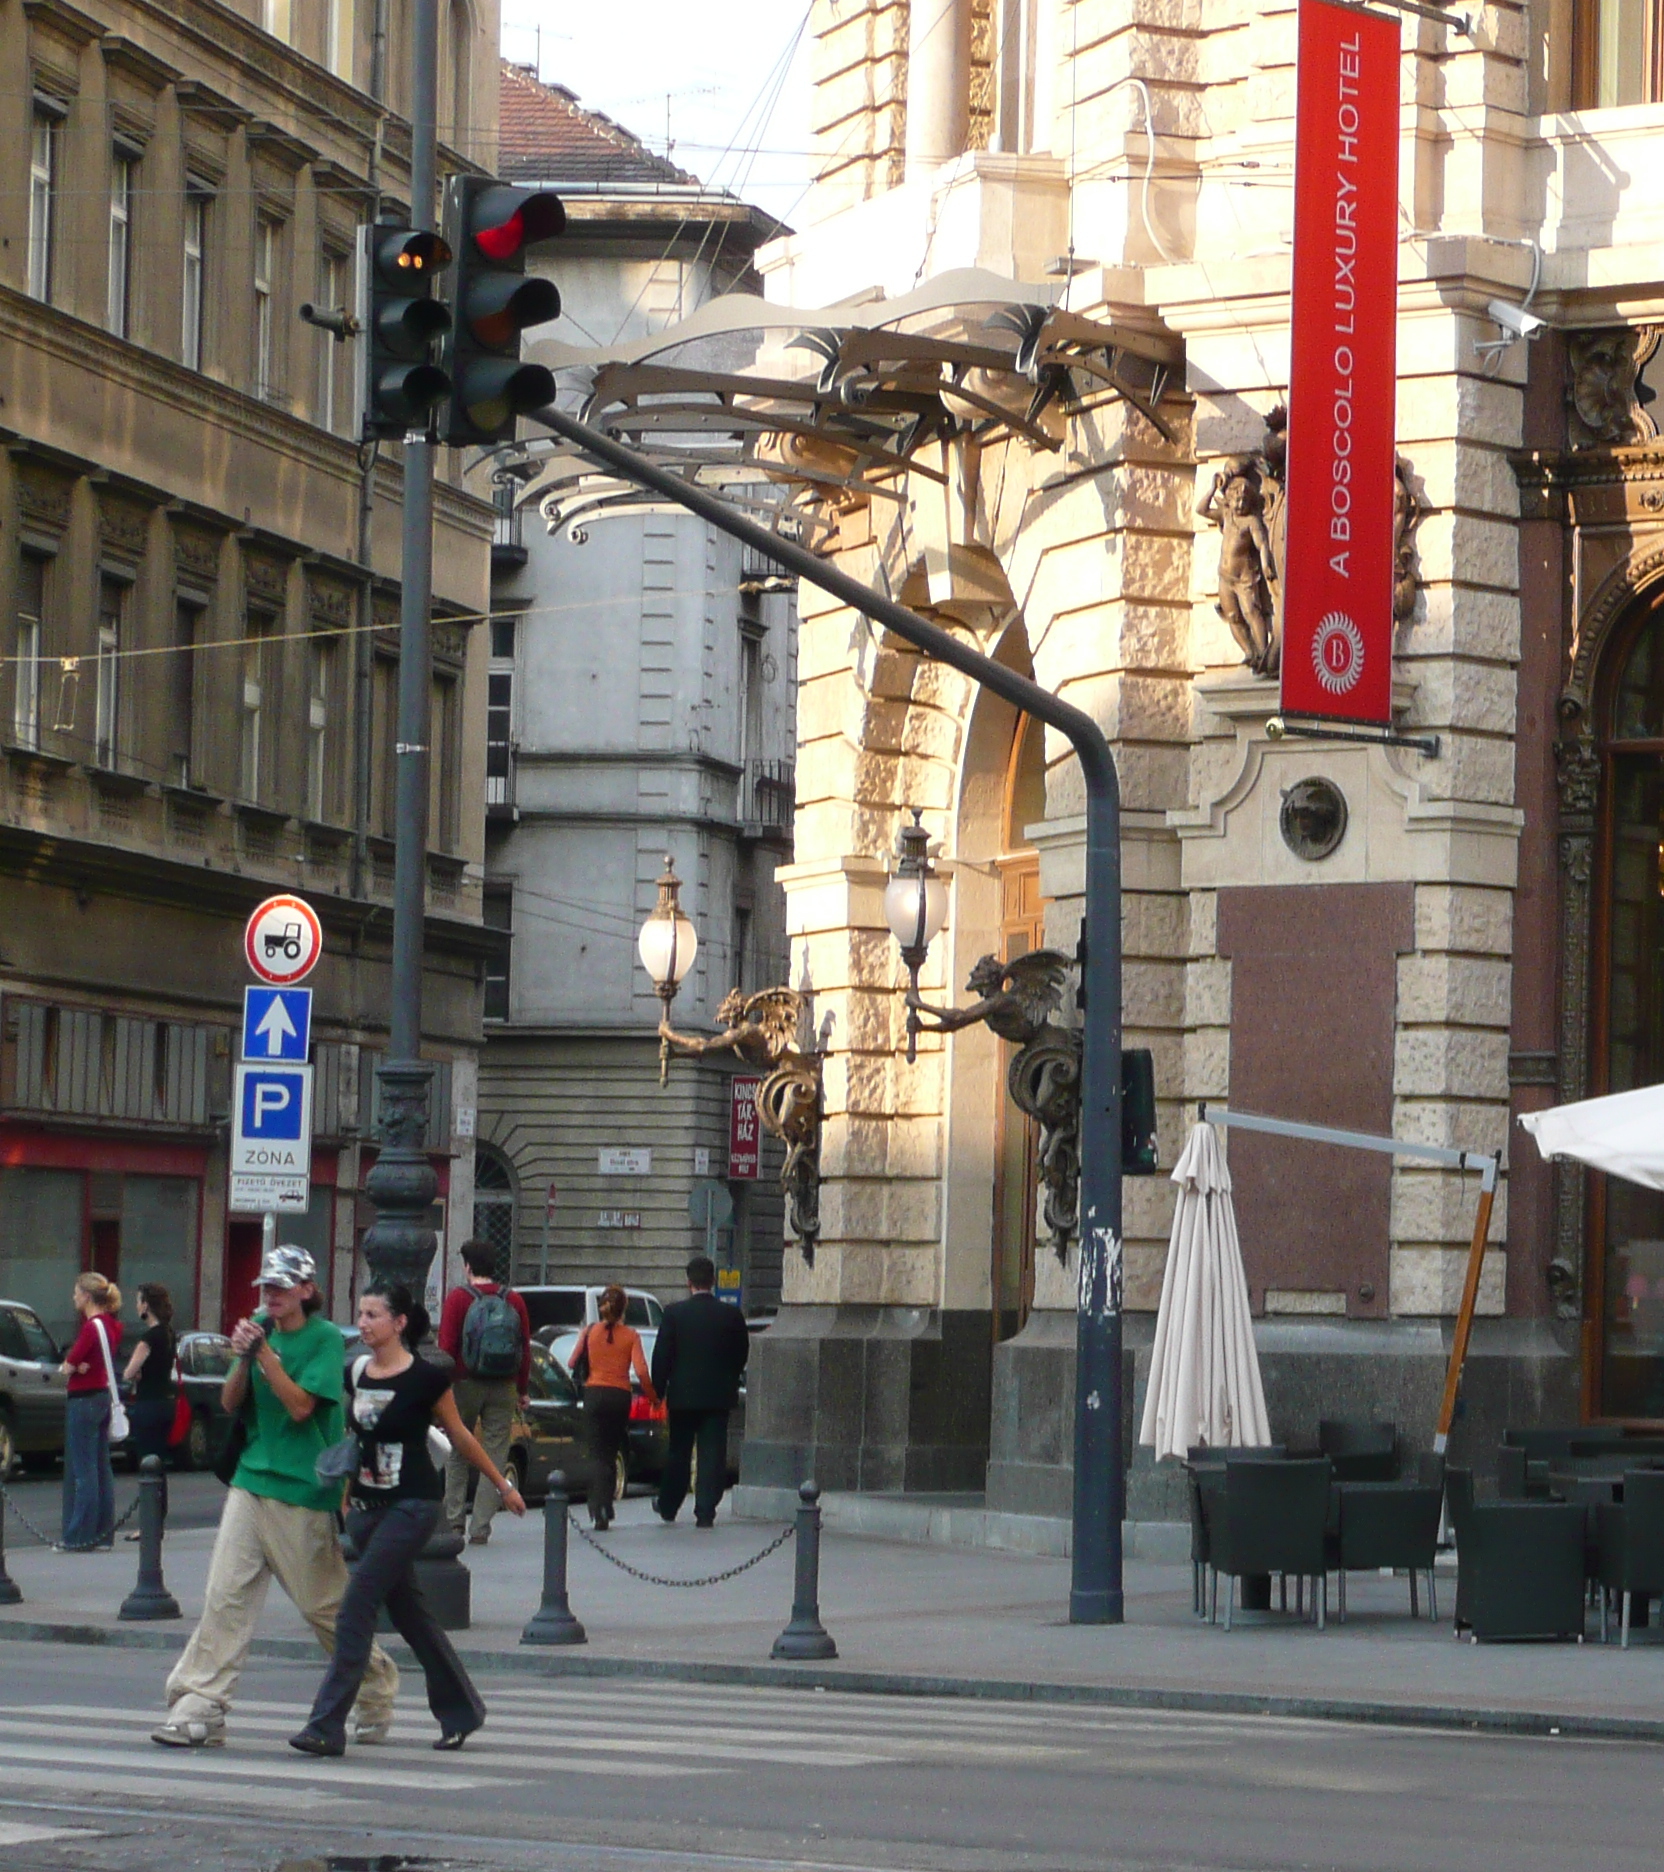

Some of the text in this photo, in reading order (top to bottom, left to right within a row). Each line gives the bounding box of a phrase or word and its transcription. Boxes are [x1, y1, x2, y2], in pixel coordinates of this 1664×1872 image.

[1329, 31, 1360, 579] A BOSCOLO LUXURY HOTEL
[1331, 638, 1345, 668] B
[253, 1082, 291, 1129] P
[737, 1121, 754, 1141] HÁZ
[244, 1147, 295, 1166] ZÓNA
